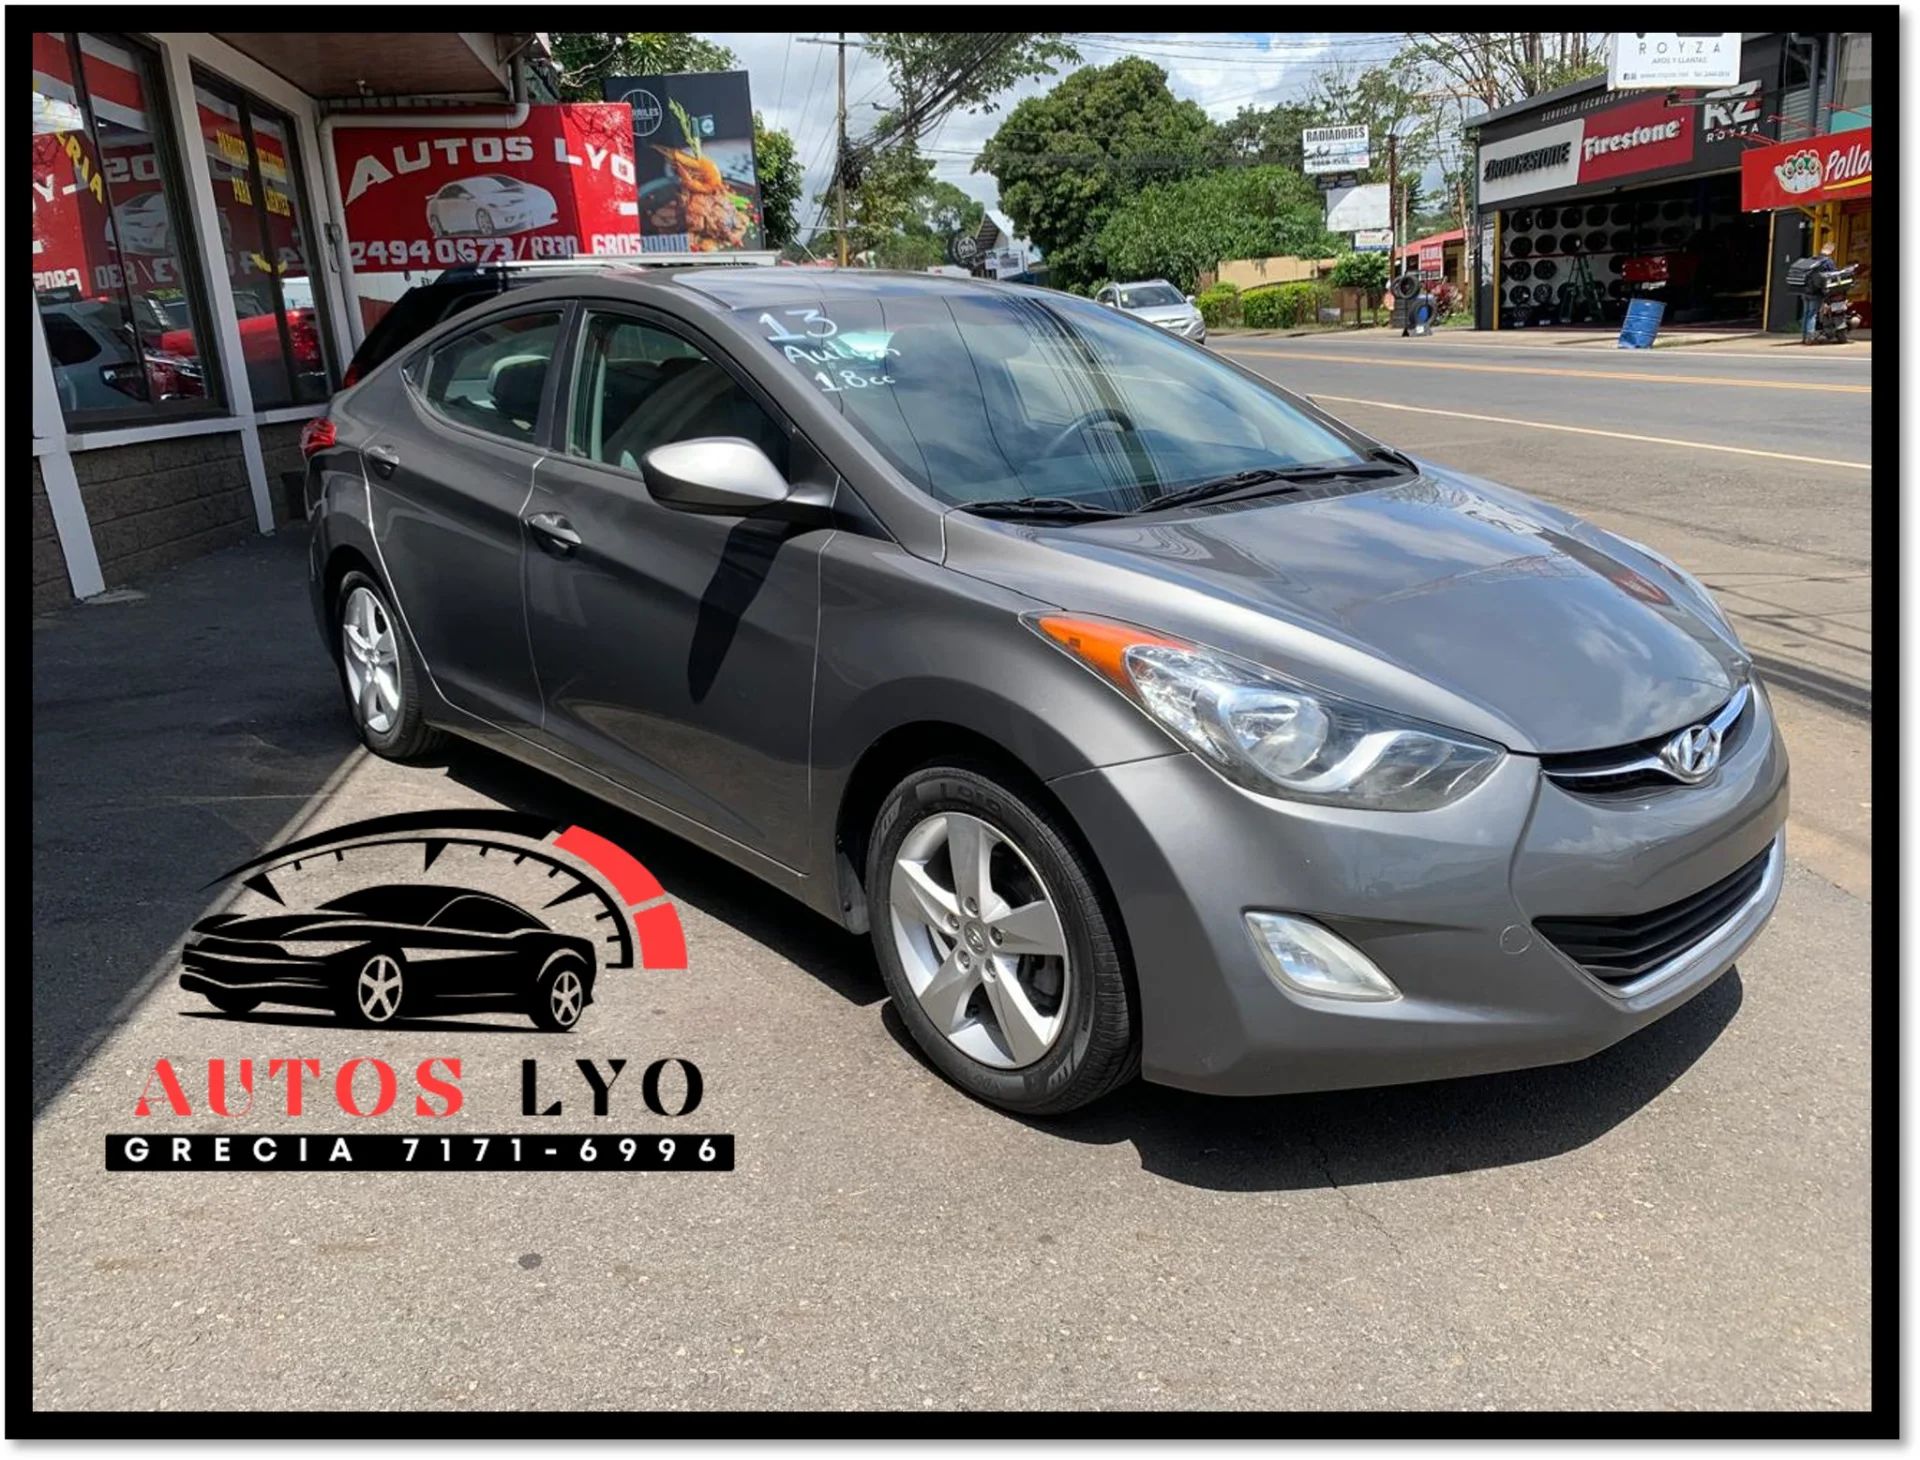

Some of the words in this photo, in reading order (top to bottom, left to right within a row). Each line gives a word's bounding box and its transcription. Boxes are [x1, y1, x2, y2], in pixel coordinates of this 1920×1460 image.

[1638, 41, 1720, 55] ROYZA
[1704, 80, 1762, 130] RZ
[1306, 127, 1365, 142] RADIADORES
[1582, 118, 1680, 162] Firestone
[1706, 123, 1759, 143] ROYZA
[345, 136, 534, 206] AUTOS
[553, 137, 635, 184] LYO
[350, 239, 431, 266] 2494
[759, 309, 838, 341] 13
[815, 370, 896, 392] 1.8cc
